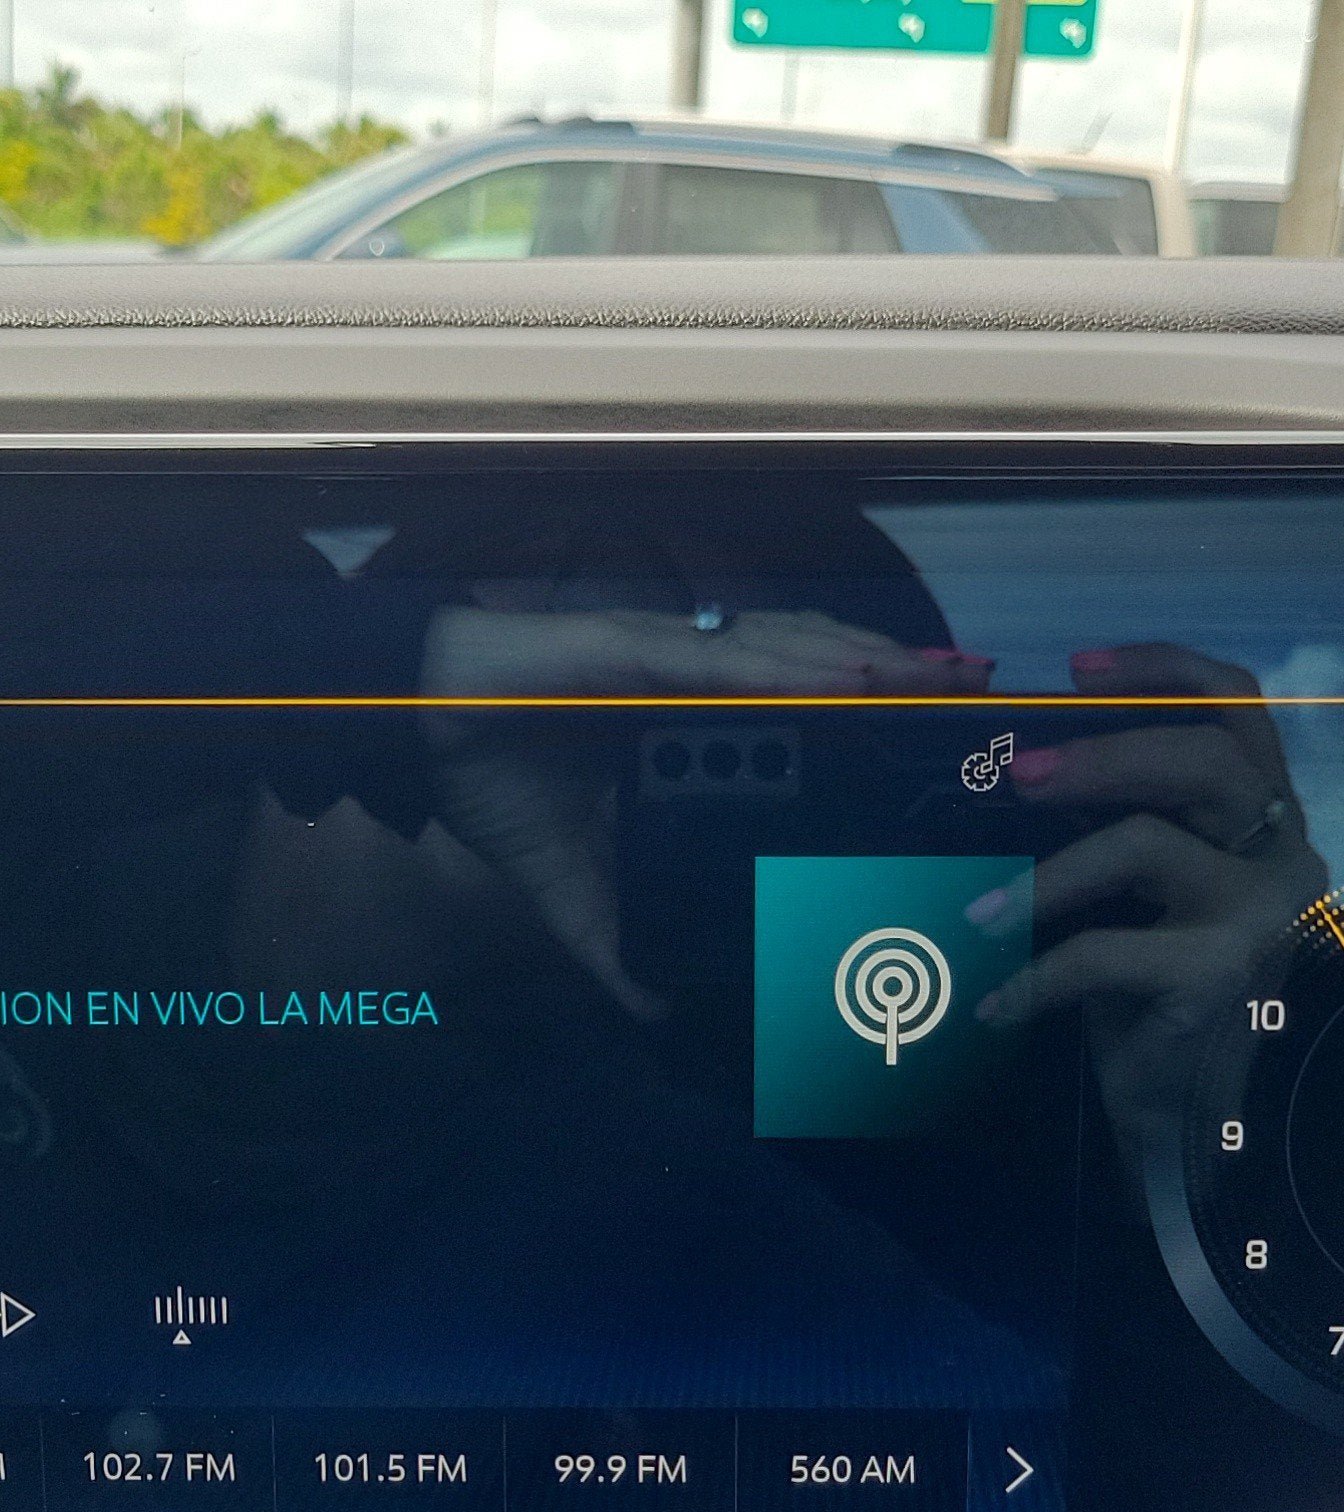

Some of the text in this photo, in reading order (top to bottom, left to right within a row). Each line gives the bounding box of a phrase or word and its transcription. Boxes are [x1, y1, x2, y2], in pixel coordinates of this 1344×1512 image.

[87, 990, 139, 1026] EN
[150, 991, 246, 1026] VIVO
[259, 990, 310, 1026] LA
[319, 990, 439, 1026] MEGA
[1246, 1000, 1285, 1031] 10
[1221, 1120, 1244, 1151] 9
[1245, 1239, 1268, 1270] 8
[83, 1451, 235, 1482] 102.7 FM
[315, 1453, 467, 1483] 101.5 FM
[554, 1454, 687, 1484] 99.9 FM
[790, 1455, 915, 1484] 560 AM
